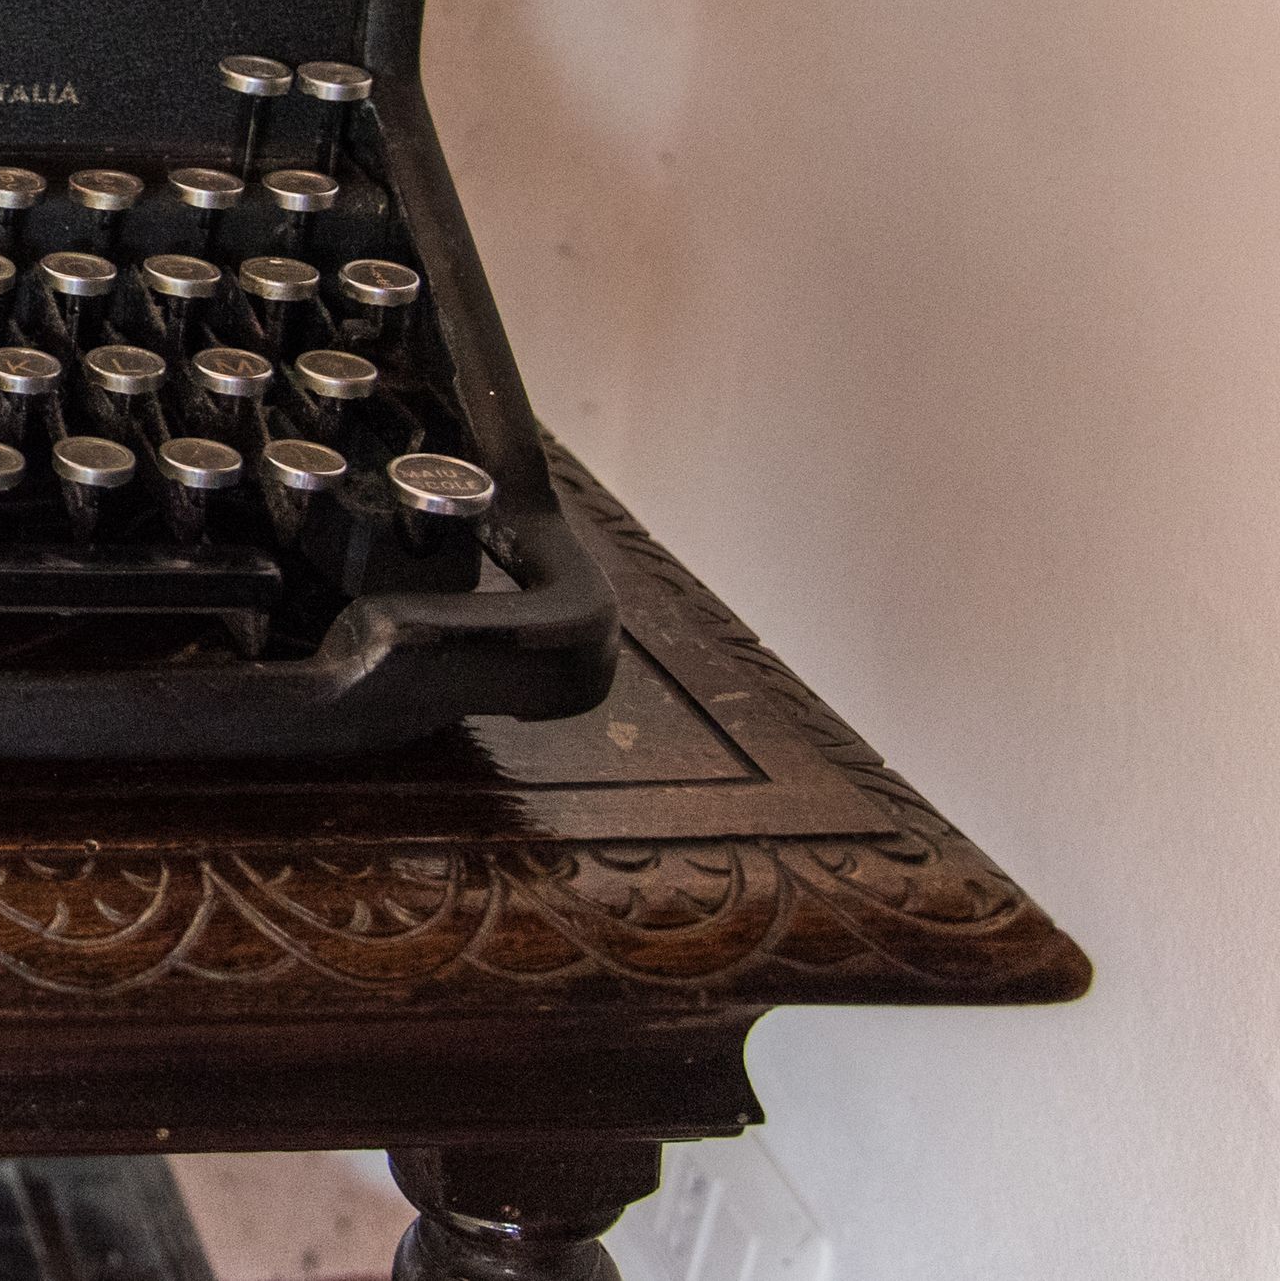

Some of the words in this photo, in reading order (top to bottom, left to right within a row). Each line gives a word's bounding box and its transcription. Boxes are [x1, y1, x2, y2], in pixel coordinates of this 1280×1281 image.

[5, 358, 37, 374] K
[110, 358, 142, 374] L
[215, 359, 256, 376] M
